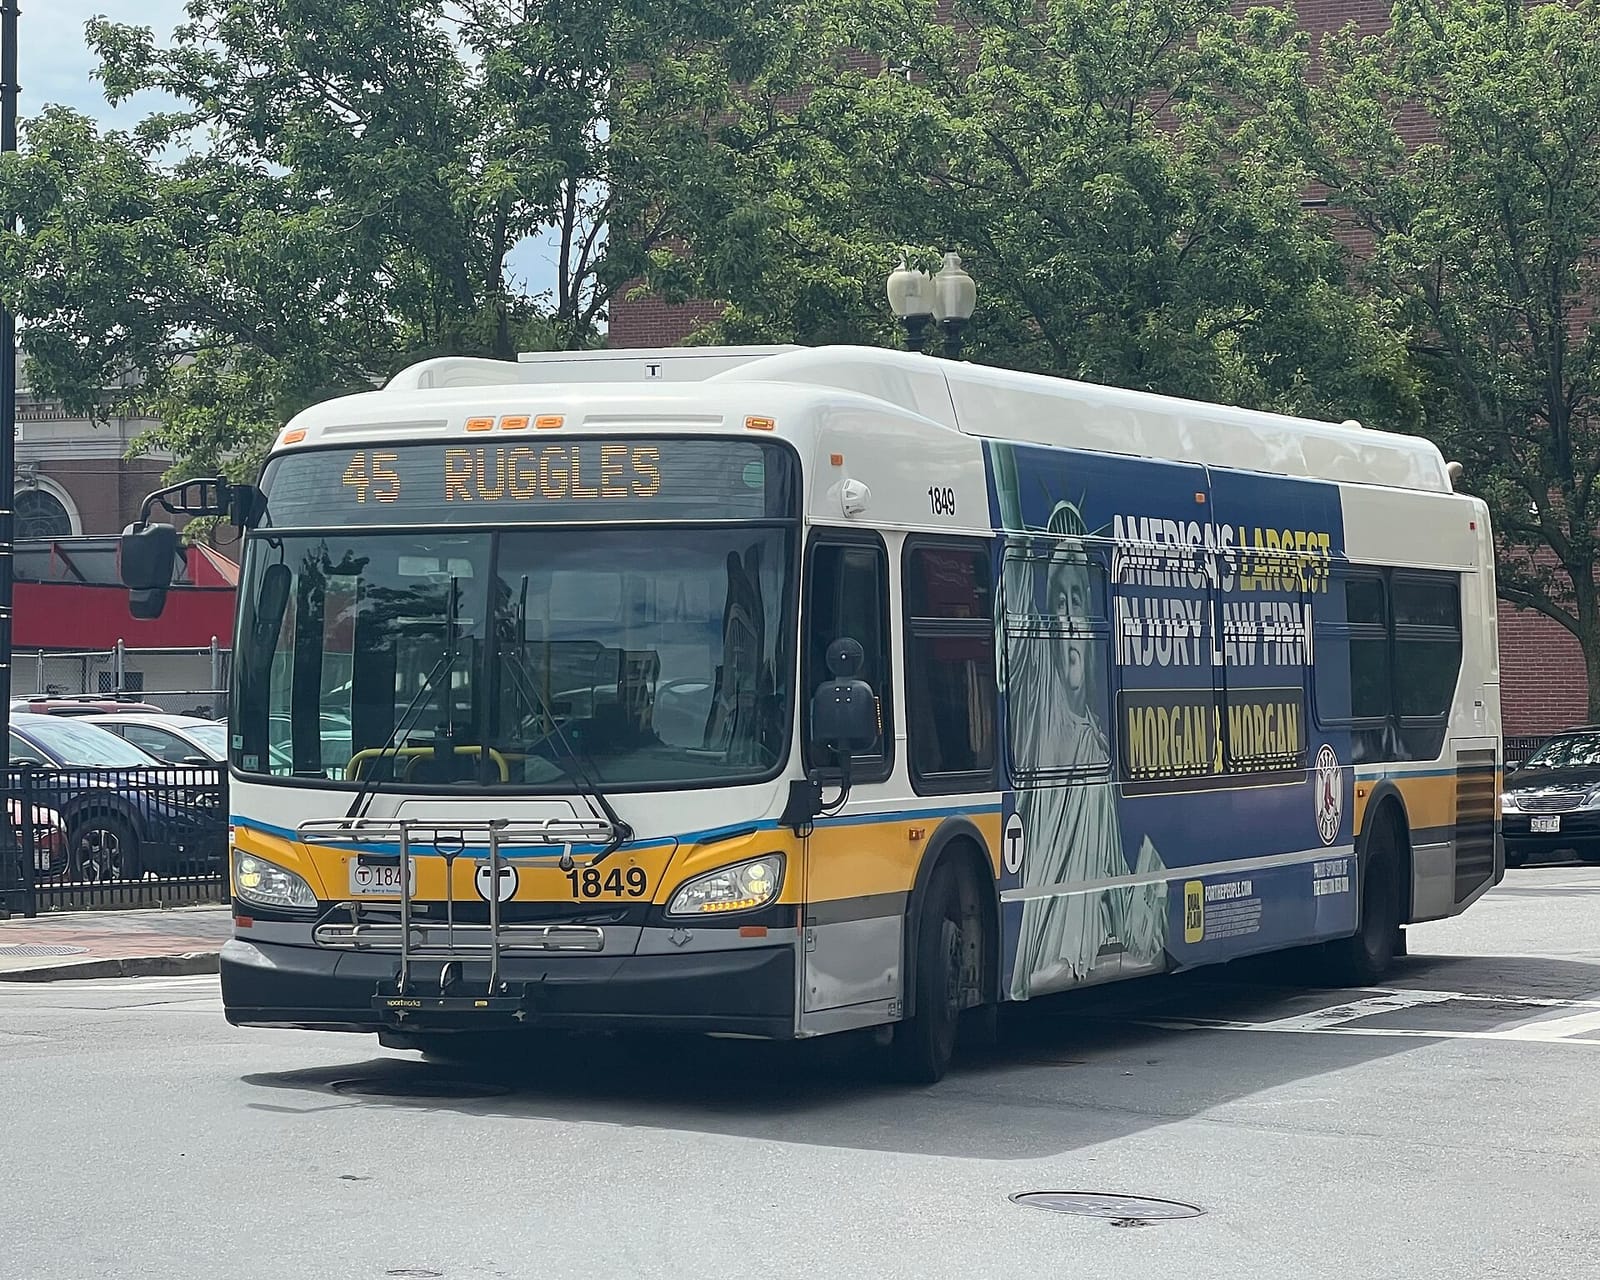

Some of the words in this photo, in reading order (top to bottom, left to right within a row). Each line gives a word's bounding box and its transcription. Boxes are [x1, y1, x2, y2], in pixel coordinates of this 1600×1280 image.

[646, 364, 660, 376] T
[342, 451, 401, 503] 45
[444, 445, 660, 501] RUGGLES
[927, 486, 956, 516] 1849
[1111, 514, 1237, 593] AMERICA'S
[1238, 526, 1331, 594] LARGEST
[1113, 596, 1202, 667] INJURY
[1210, 600, 1258, 667] LAW
[1259, 602, 1314, 667] FIRM
[1128, 705, 1208, 779] MORGAN
[1228, 703, 1298, 773] MORGAN
[1007, 827, 1022, 865] T
[375, 866, 412, 887] 184
[566, 867, 647, 898] 1849
